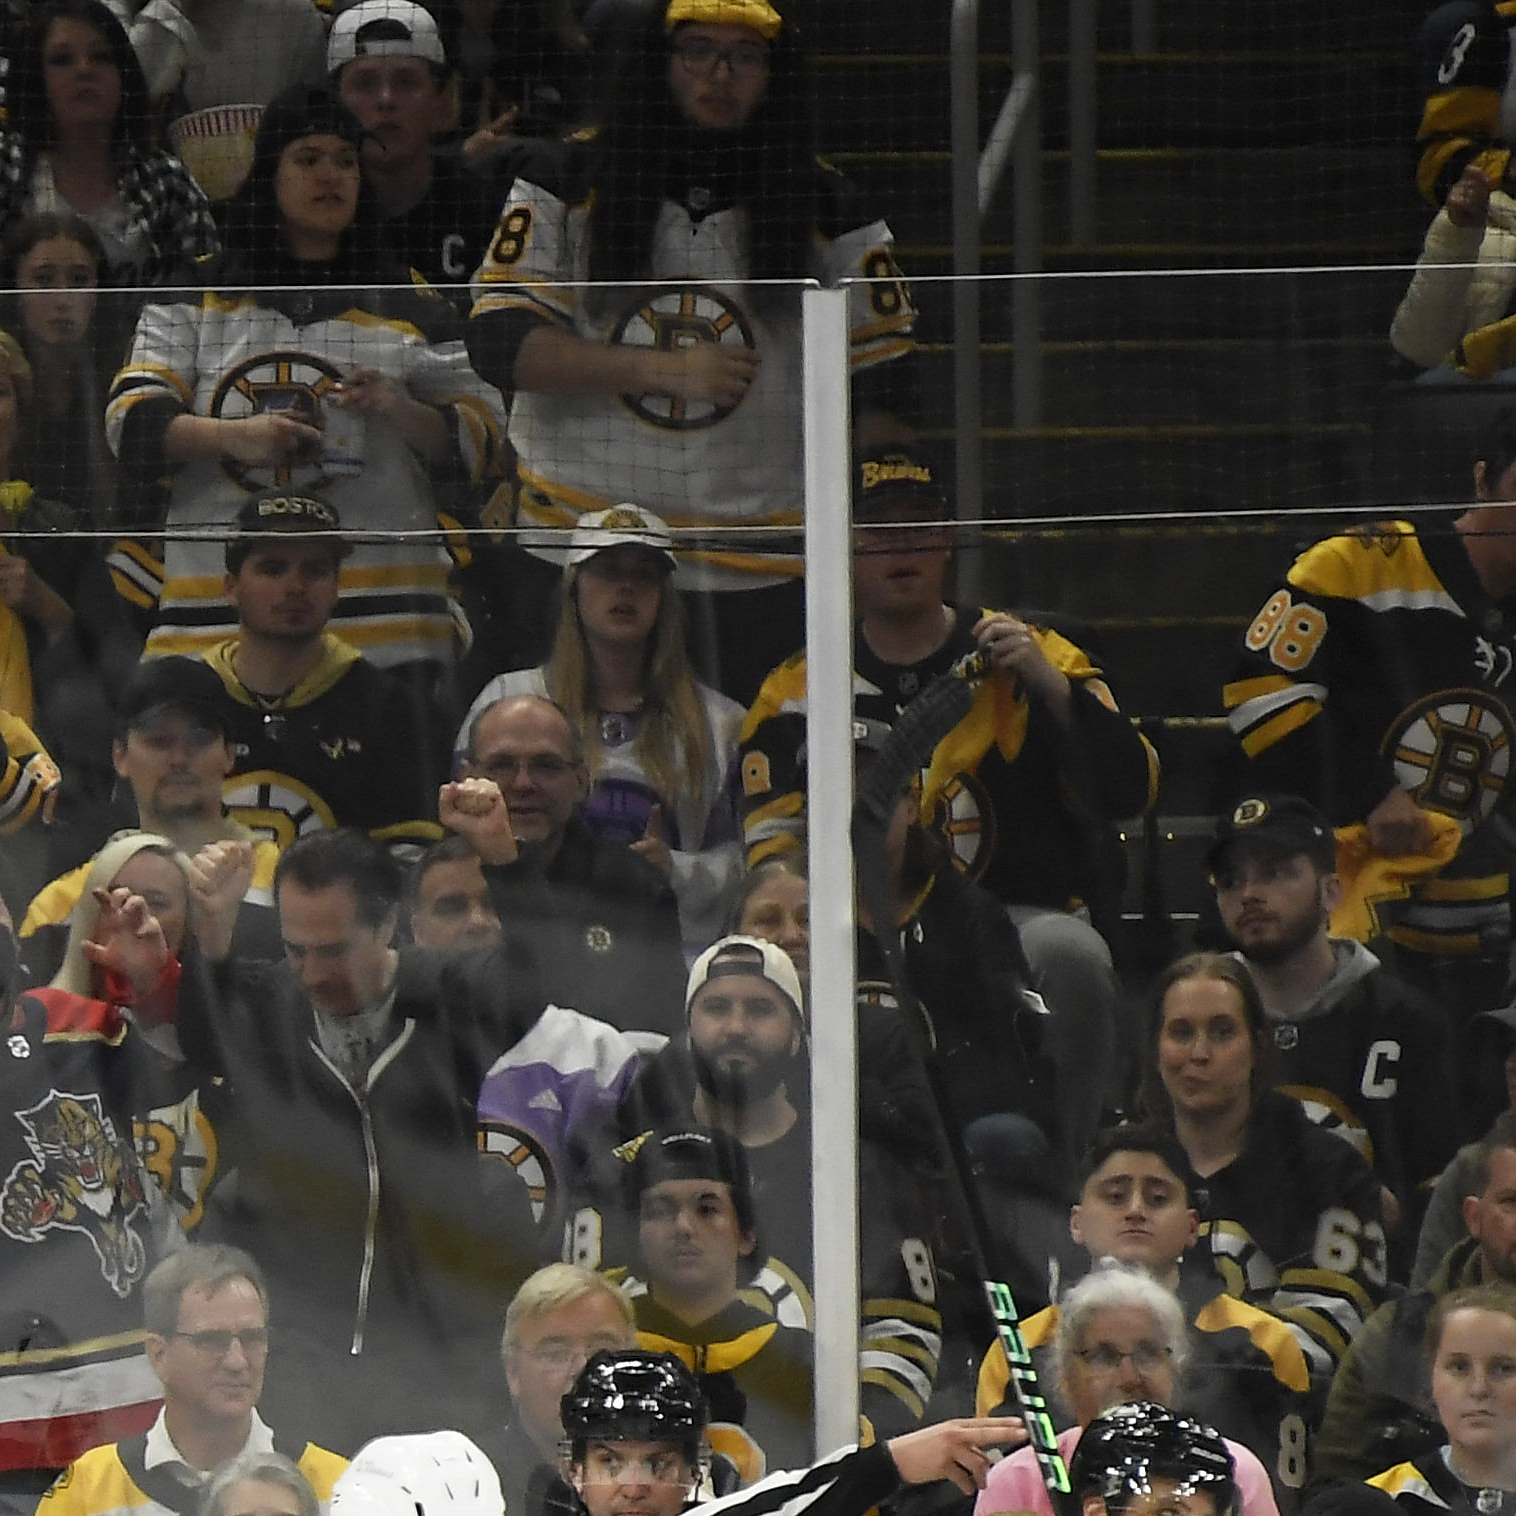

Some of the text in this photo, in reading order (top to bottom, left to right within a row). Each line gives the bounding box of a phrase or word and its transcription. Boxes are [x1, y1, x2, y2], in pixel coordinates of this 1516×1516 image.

[441, 233, 465, 276] C
[492, 206, 532, 264] 8
[257, 496, 333, 522] BOSTO
[1244, 587, 1328, 672] 88
[1360, 1039, 1402, 1100] C
[1314, 1205, 1388, 1290] 63
[1278, 1413, 1306, 1489] 8
